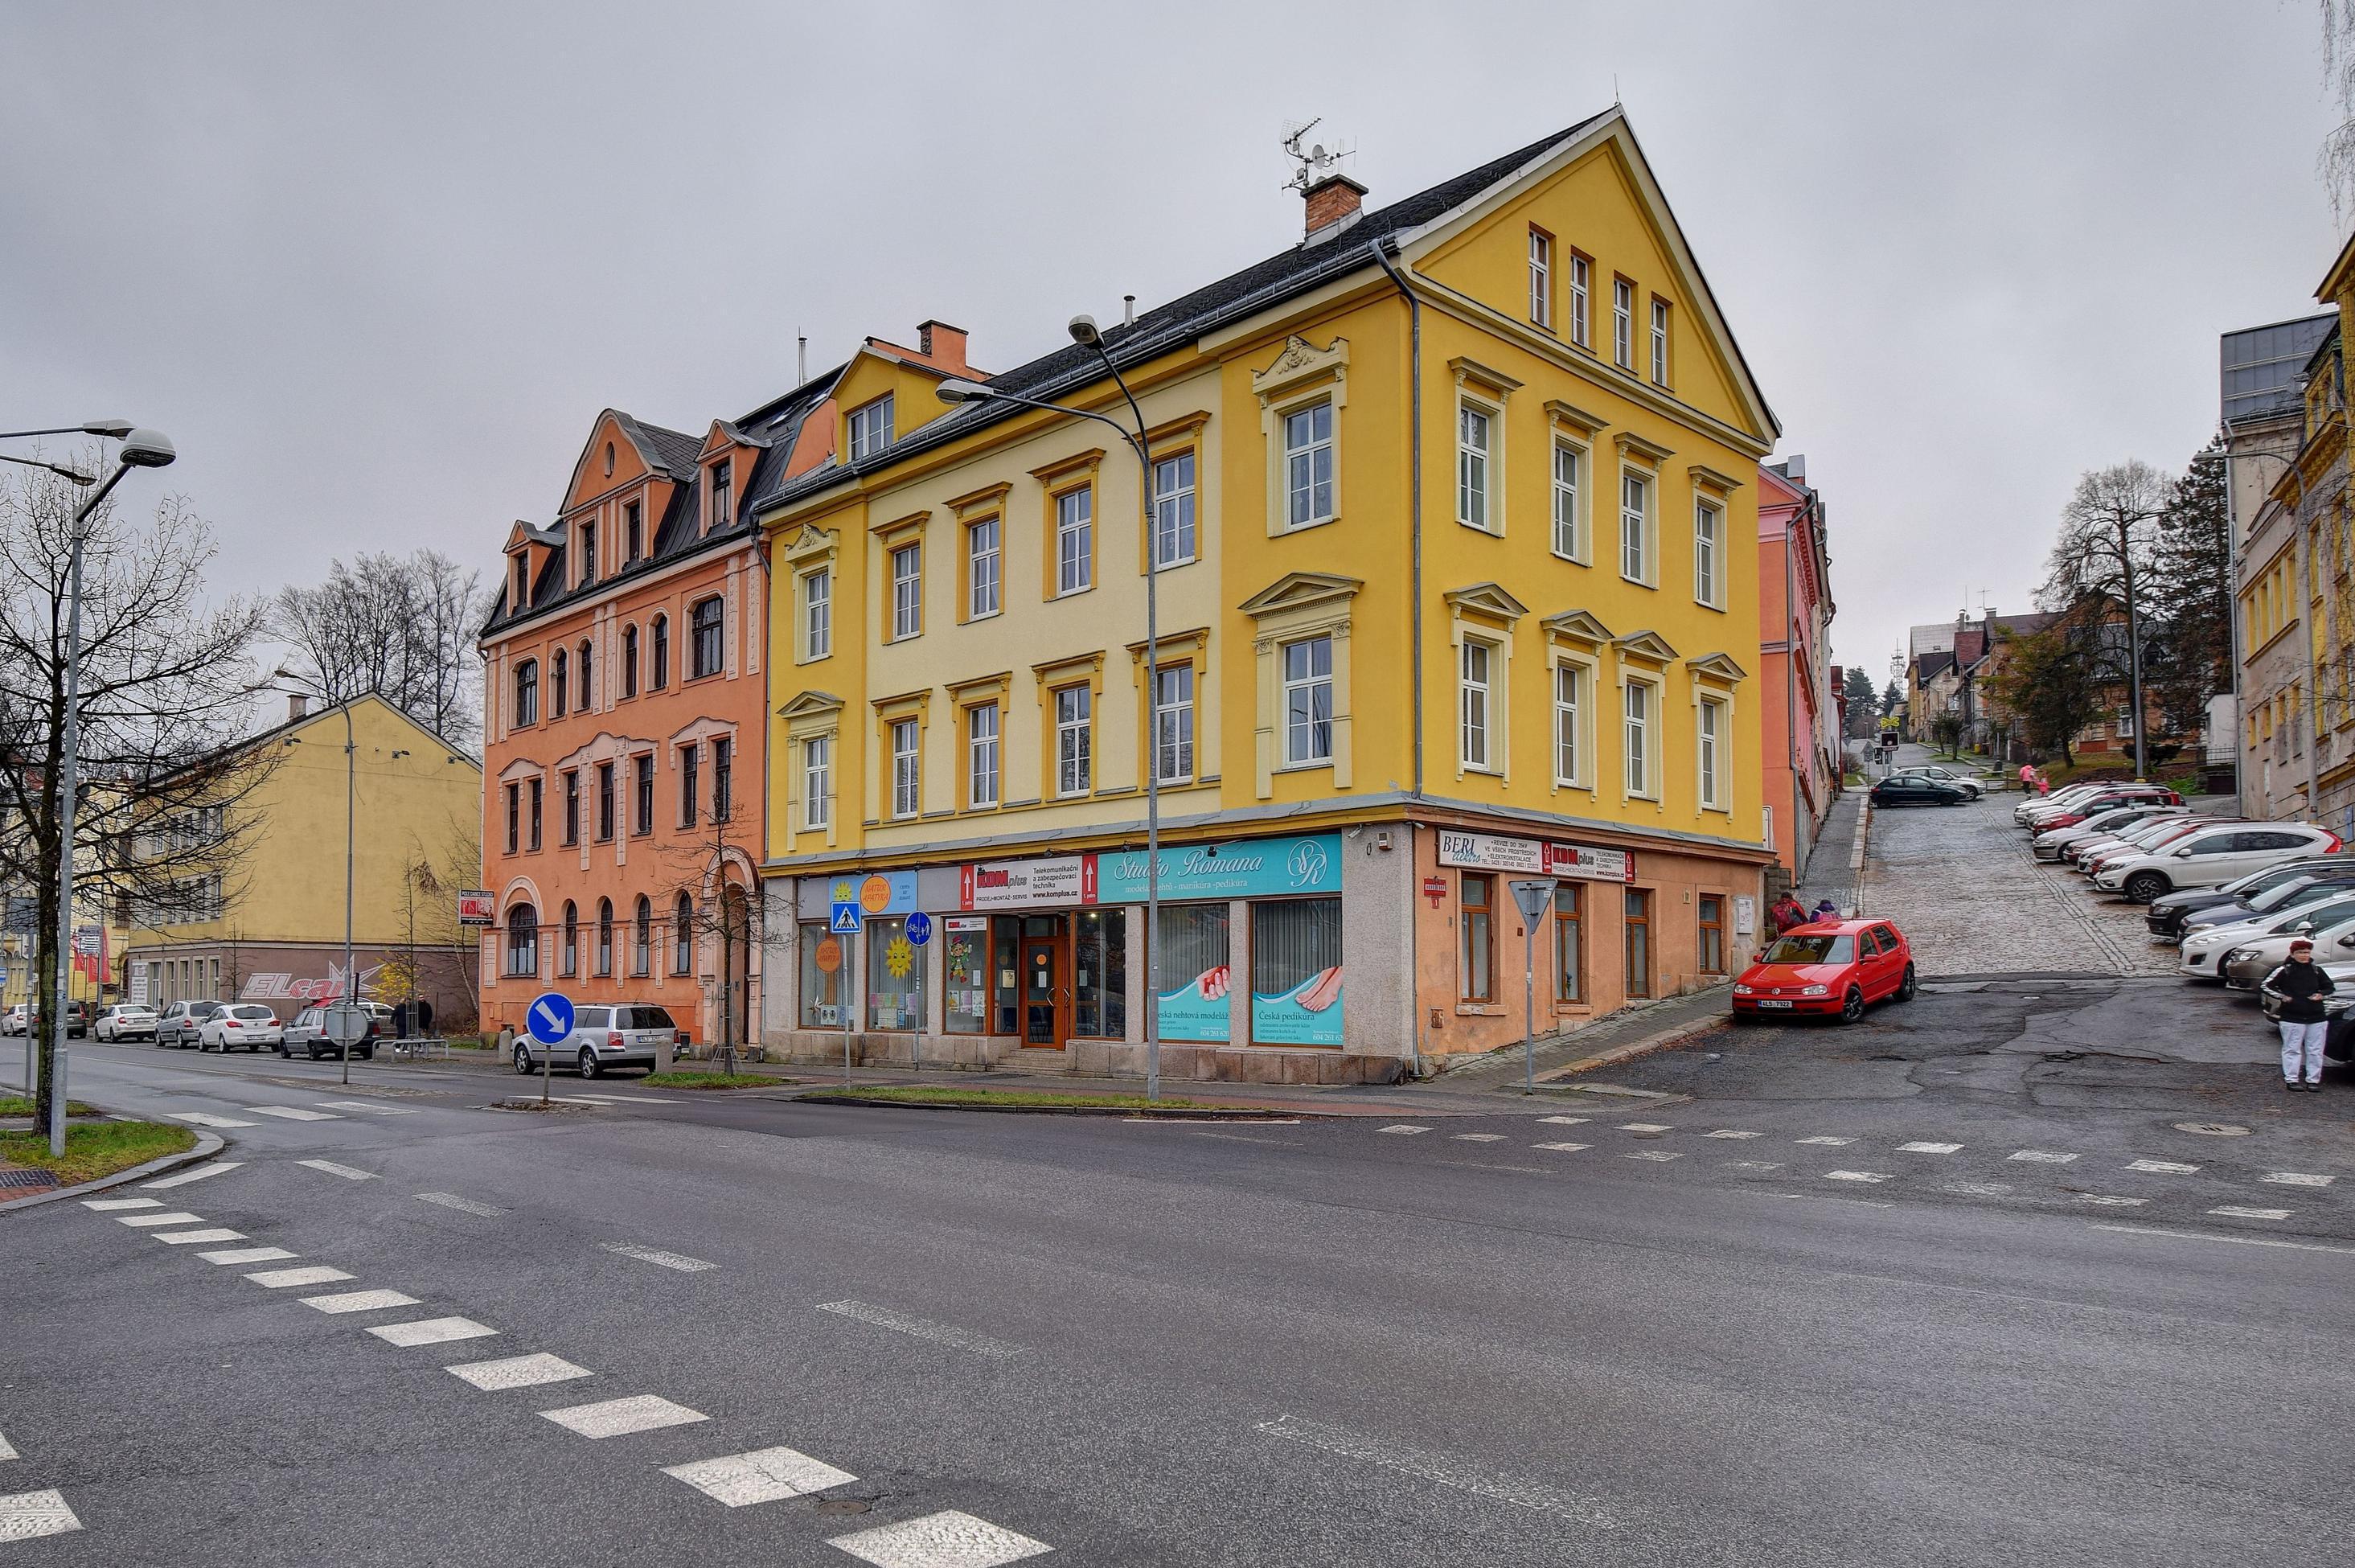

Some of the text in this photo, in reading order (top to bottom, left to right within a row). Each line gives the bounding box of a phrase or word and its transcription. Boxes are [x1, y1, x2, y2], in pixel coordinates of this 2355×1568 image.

[1443, 836, 1475, 853] BERI
[1452, 848, 1480, 863] elektro
[1178, 849, 1264, 876] Romana
[1033, 864, 1078, 874] Telekomunikační
[1037, 872, 1077, 881] zabezpečovací
[1032, 890, 1078, 898] www.komplus.cz
[241, 973, 347, 999] ELcar
[1158, 1011, 1229, 1020] eská nehtová modeláž
[1259, 1010, 1315, 1022] Česká pedikúra
